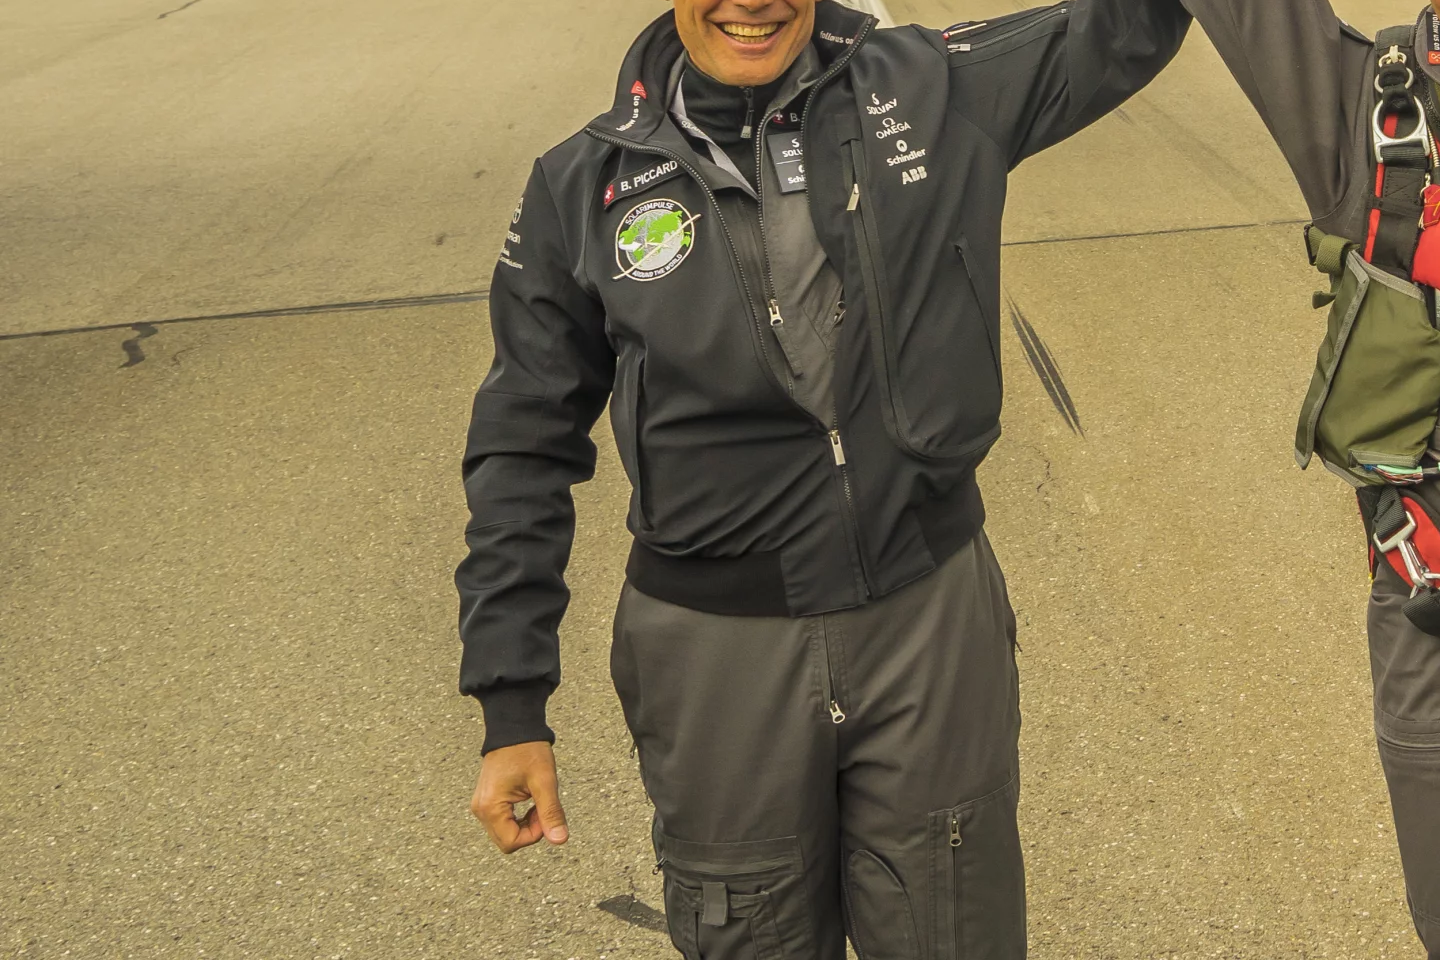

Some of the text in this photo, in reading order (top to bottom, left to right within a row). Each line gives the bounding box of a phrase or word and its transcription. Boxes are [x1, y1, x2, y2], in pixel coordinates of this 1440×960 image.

[633, 95, 641, 106] on
[866, 98, 898, 115] SOLVAY
[632, 108, 639, 119] us
[876, 121, 912, 140] OMEGA
[886, 148, 926, 167] Schindler
[620, 160, 679, 192] B. PICCARD
[901, 165, 928, 185] ABB
[624, 201, 675, 226] SOLARIMPULSE
[665, 253, 683, 272] WORLD
